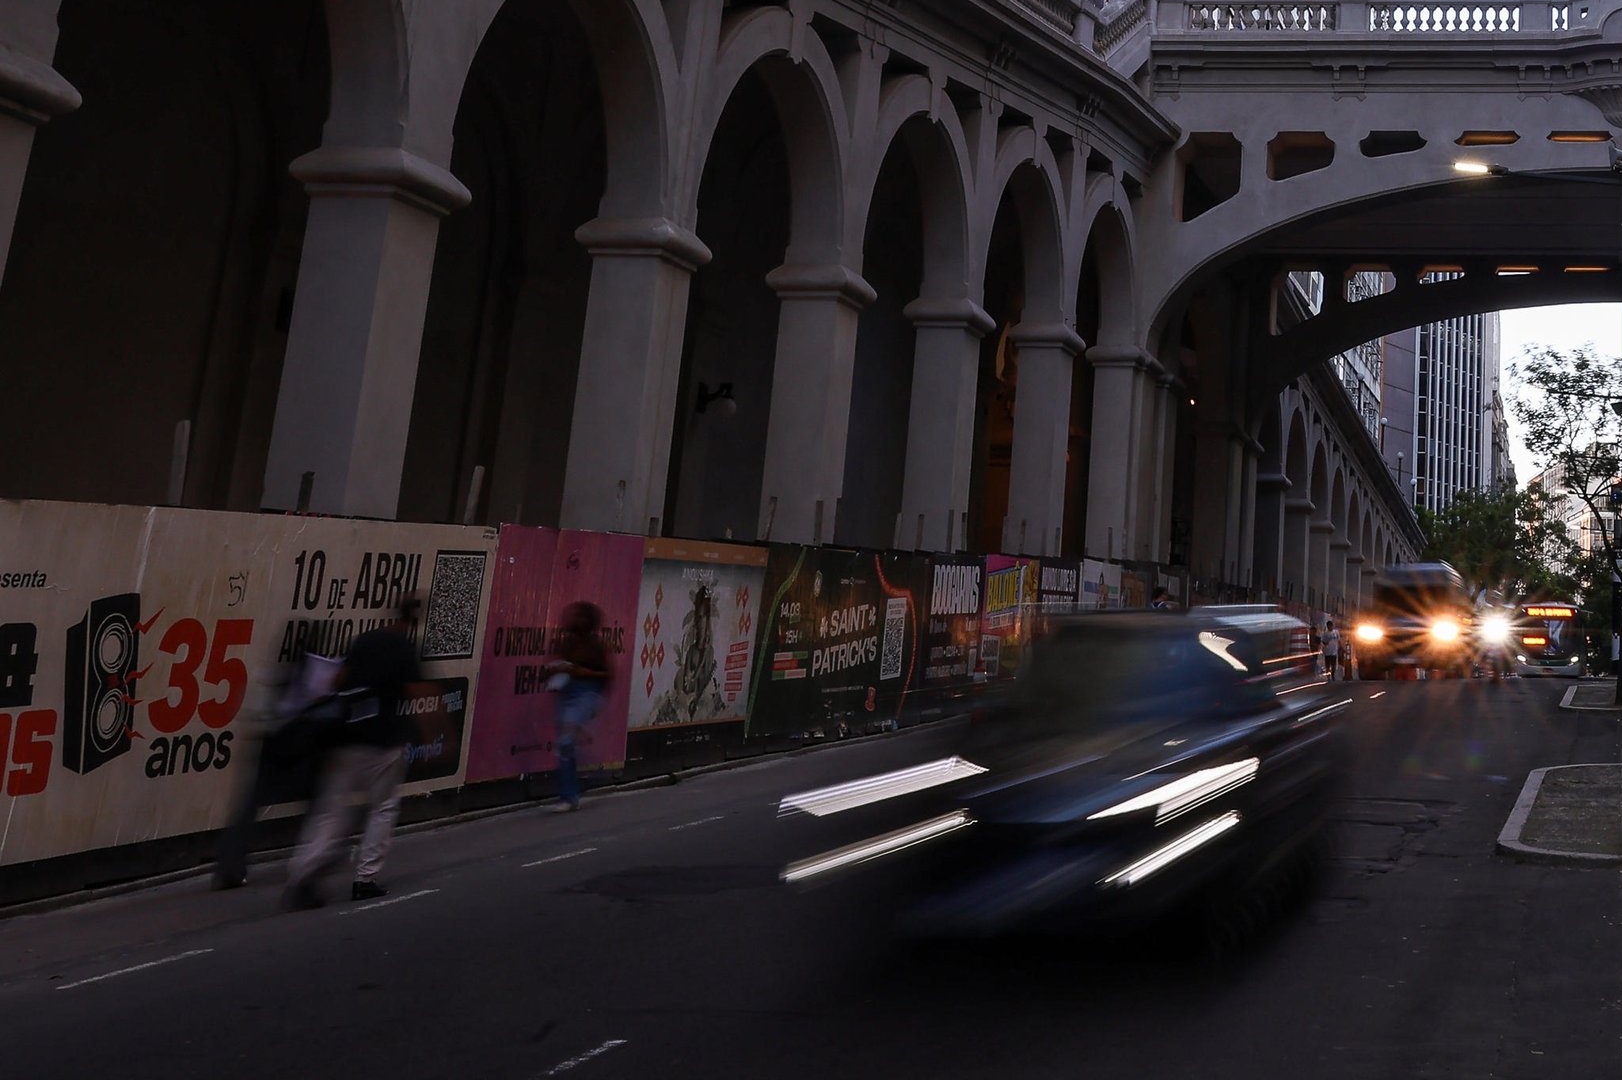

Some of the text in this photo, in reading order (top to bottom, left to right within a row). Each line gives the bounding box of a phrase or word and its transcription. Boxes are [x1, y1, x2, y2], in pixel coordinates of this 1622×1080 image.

[0, 570, 47, 588] senta
[291, 550, 422, 610] 10 DE ABRIL
[931, 564, 980, 615] BOOGARINS
[494, 627, 503, 655] O
[505, 627, 546, 656] VIRTUAL
[830, 604, 869, 637] SAINT
[148, 618, 254, 733] 35
[811, 636, 878, 678] PATRICK'S
[514, 665, 537, 695] VEM
[0, 709, 57, 796] S
[145, 730, 234, 778] anos
